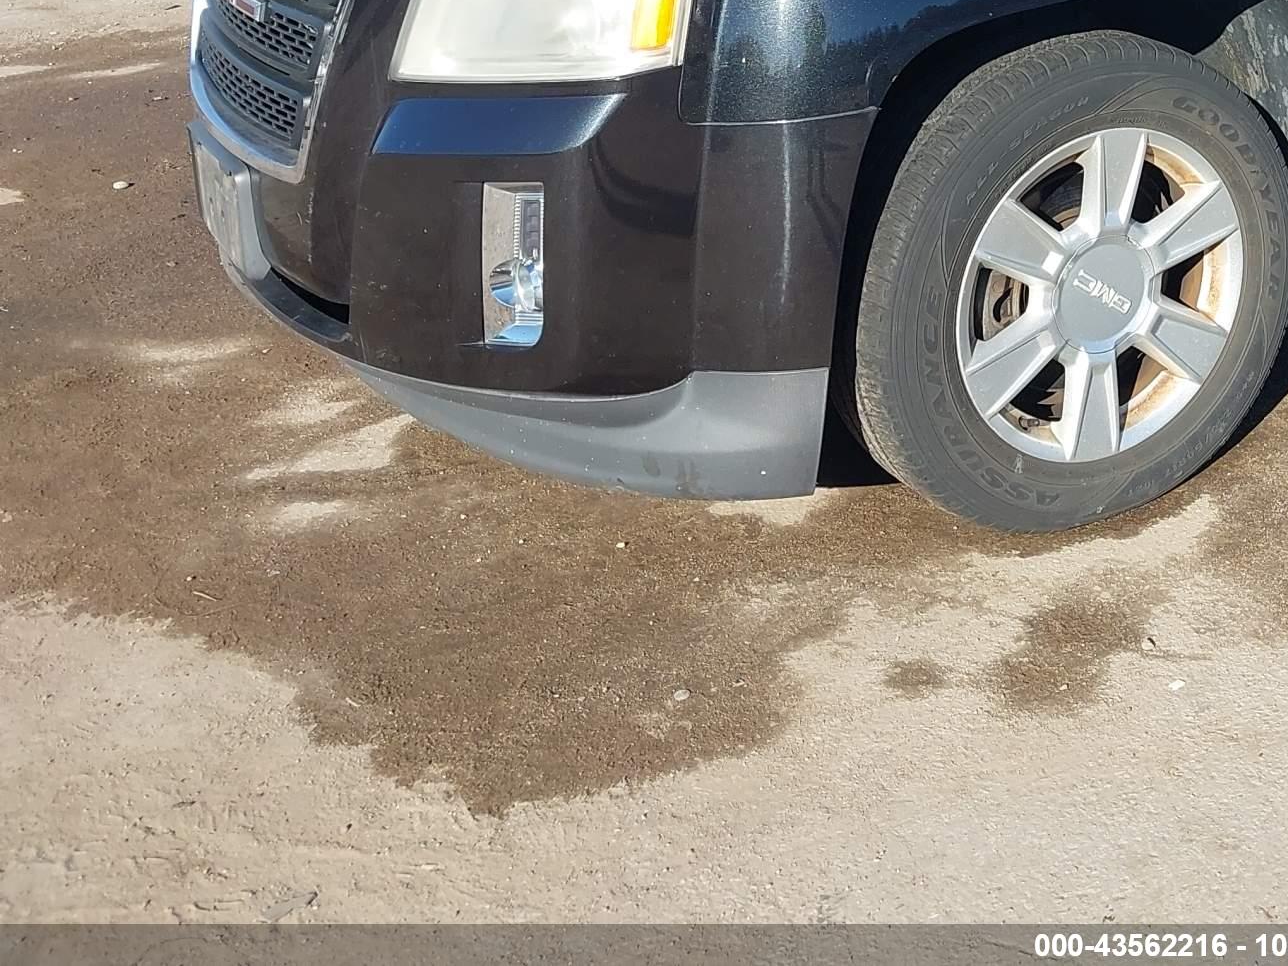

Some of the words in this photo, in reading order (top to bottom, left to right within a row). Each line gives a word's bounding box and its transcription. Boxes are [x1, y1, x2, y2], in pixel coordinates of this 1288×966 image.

[1073, 269, 1133, 314] GMC
[1172, 96, 1283, 300] GOODYEAR
[921, 286, 1062, 510] ASSURANCE
